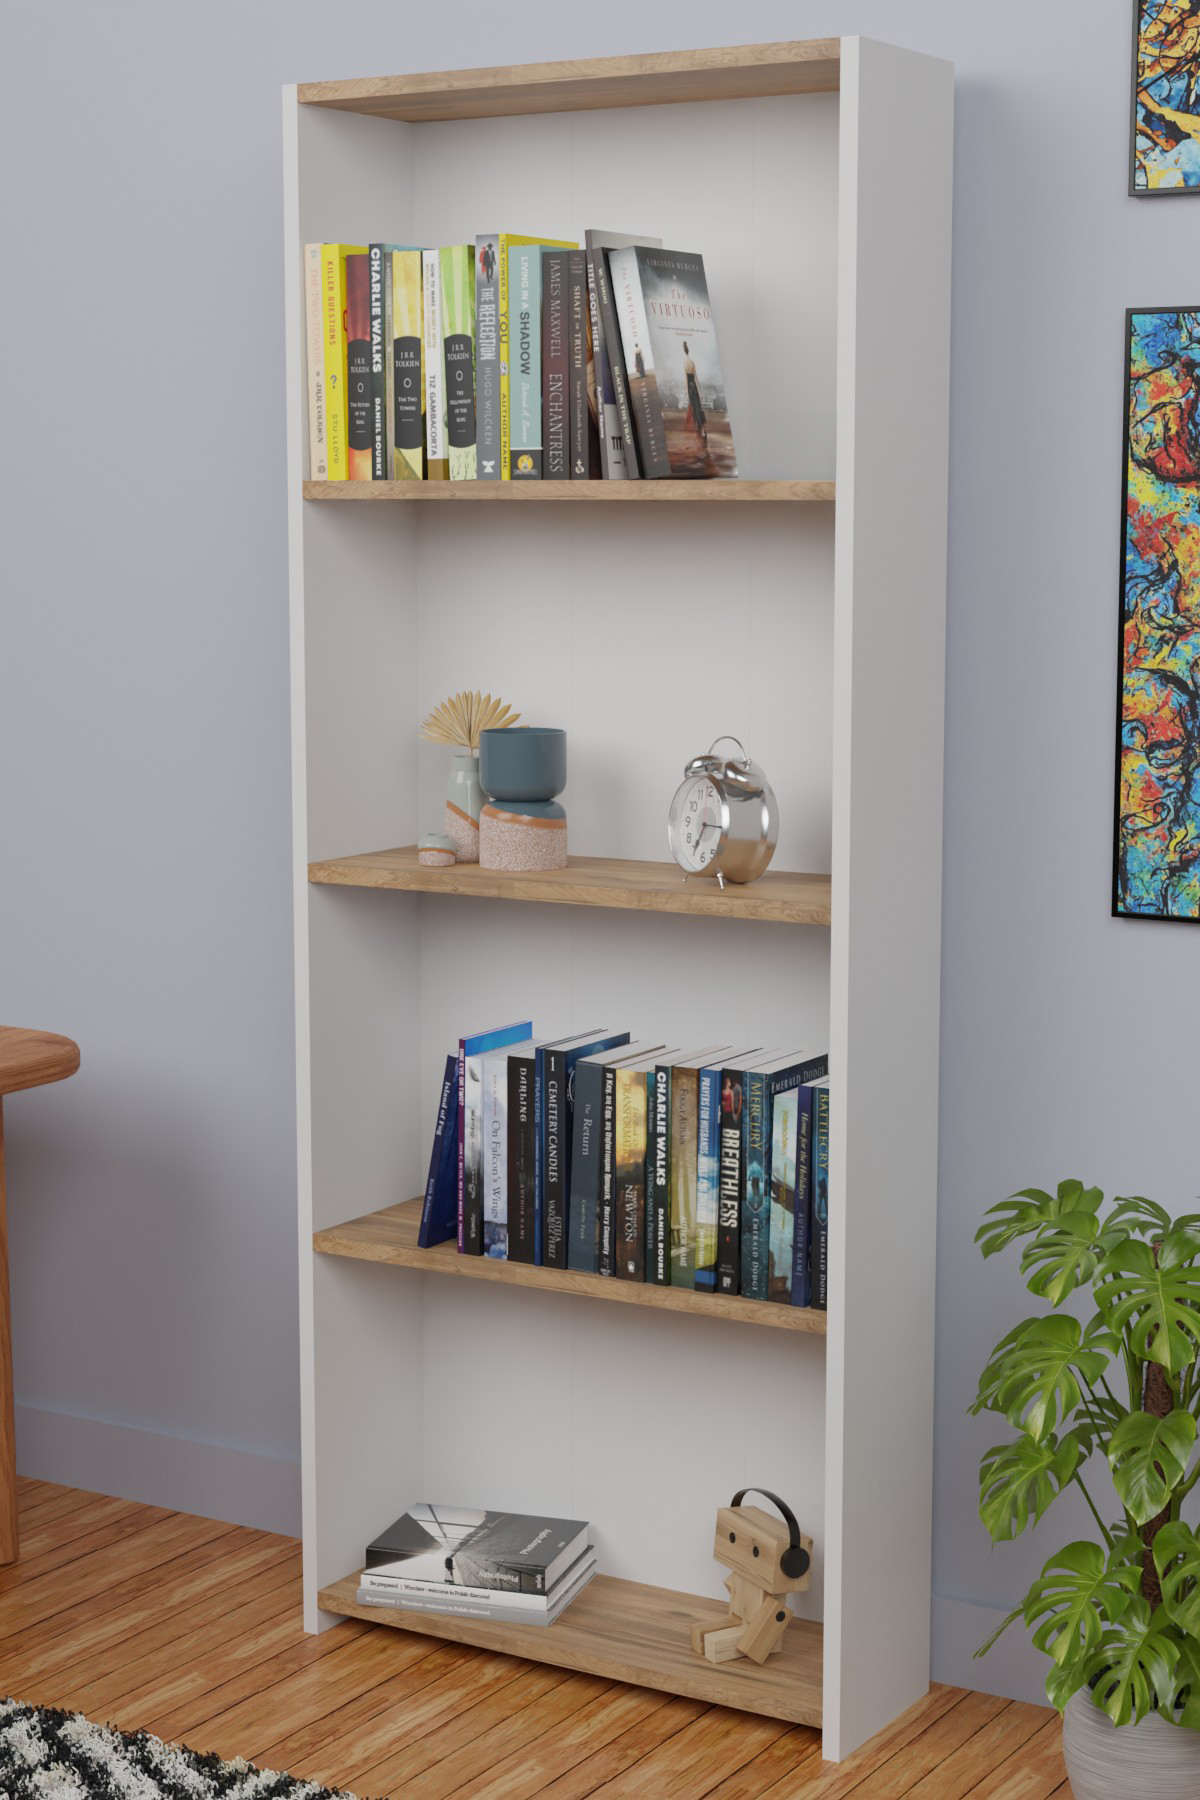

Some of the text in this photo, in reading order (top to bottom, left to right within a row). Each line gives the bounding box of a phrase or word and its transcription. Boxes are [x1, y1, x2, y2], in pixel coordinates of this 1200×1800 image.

[520, 256, 529, 288] LIVING
[501, 290, 506, 301] OF
[521, 290, 529, 300] IN
[550, 260, 561, 358] JAMES MAXWELL
[589, 293, 597, 323] GOES
[599, 278, 608, 304] WHOO
[671, 289, 686, 300] The
[328, 296, 336, 346] QUESTIONS
[370, 247, 382, 373] CHARLIE WALKS
[479, 287, 496, 360] THE REFLECTION
[500, 310, 508, 344] YOU
[624, 285, 638, 337] VIRTUOSO
[651, 303, 710, 320] VIRTUOSO
[520, 312, 530, 375] SHADOW
[592, 326, 600, 352] HERE
[484, 367, 492, 445] HUGO WILCKEN
[613, 366, 632, 445] BLACK IN THE TRAP
[641, 382, 651, 424] VIRGINIA
[429, 392, 438, 456] GAMBACORTA
[549, 374, 563, 472] ENCHANTRESS
[689, 801, 697, 812] 10
[698, 790, 703, 801] 11
[707, 785, 714, 797] 12
[685, 816, 691, 827] 9
[686, 833, 692, 844] 8
[700, 852, 706, 863] 6
[459, 1076, 464, 1086] OR
[518, 1067, 527, 1122] DARLING
[605, 1079, 613, 1094] Key,
[700, 1077, 710, 1106] PRAYERS
[772, 1066, 824, 1092] EMERALD DODGE
[436, 1081, 451, 1136] Island of Fog
[605, 1096, 611, 1104] an
[679, 1088, 689, 1145] FOGGY AUTUMN
[700, 1107, 709, 1119] FOR
[750, 1082, 763, 1151] MERCURY
[548, 1081, 557, 1183] CEMETERY CANDLES
[582, 1118, 592, 1156] Return
[605, 1121, 611, 1130] an
[656, 1072, 667, 1186] CHARLIE WALKS
[699, 1120, 709, 1156] HUSBANDS,
[818, 1093, 829, 1170] BATTLECRY
[490, 1120, 501, 1219] On Falcon's Wings
[604, 1132, 612, 1172] Unfortunate
[698, 1157, 708, 1176] WIVES
[798, 1112, 809, 1200] Home for the Holidays
[603, 1174, 611, 1201] Remark
[698, 1178, 707, 1191] AND
[720, 1128, 739, 1228] BREATHLESS
[423, 1195, 433, 1223] Robinson
[602, 1206, 610, 1224] Harry
[624, 1184, 634, 1243] NEWTON
[547, 1200, 556, 1259] VAZQUEZ PEREZ
[679, 1216, 688, 1267] AUTHOR NAME
[796, 1212, 804, 1249] AUTHOR
[751, 1218, 760, 1291] EMERALD DODGE
